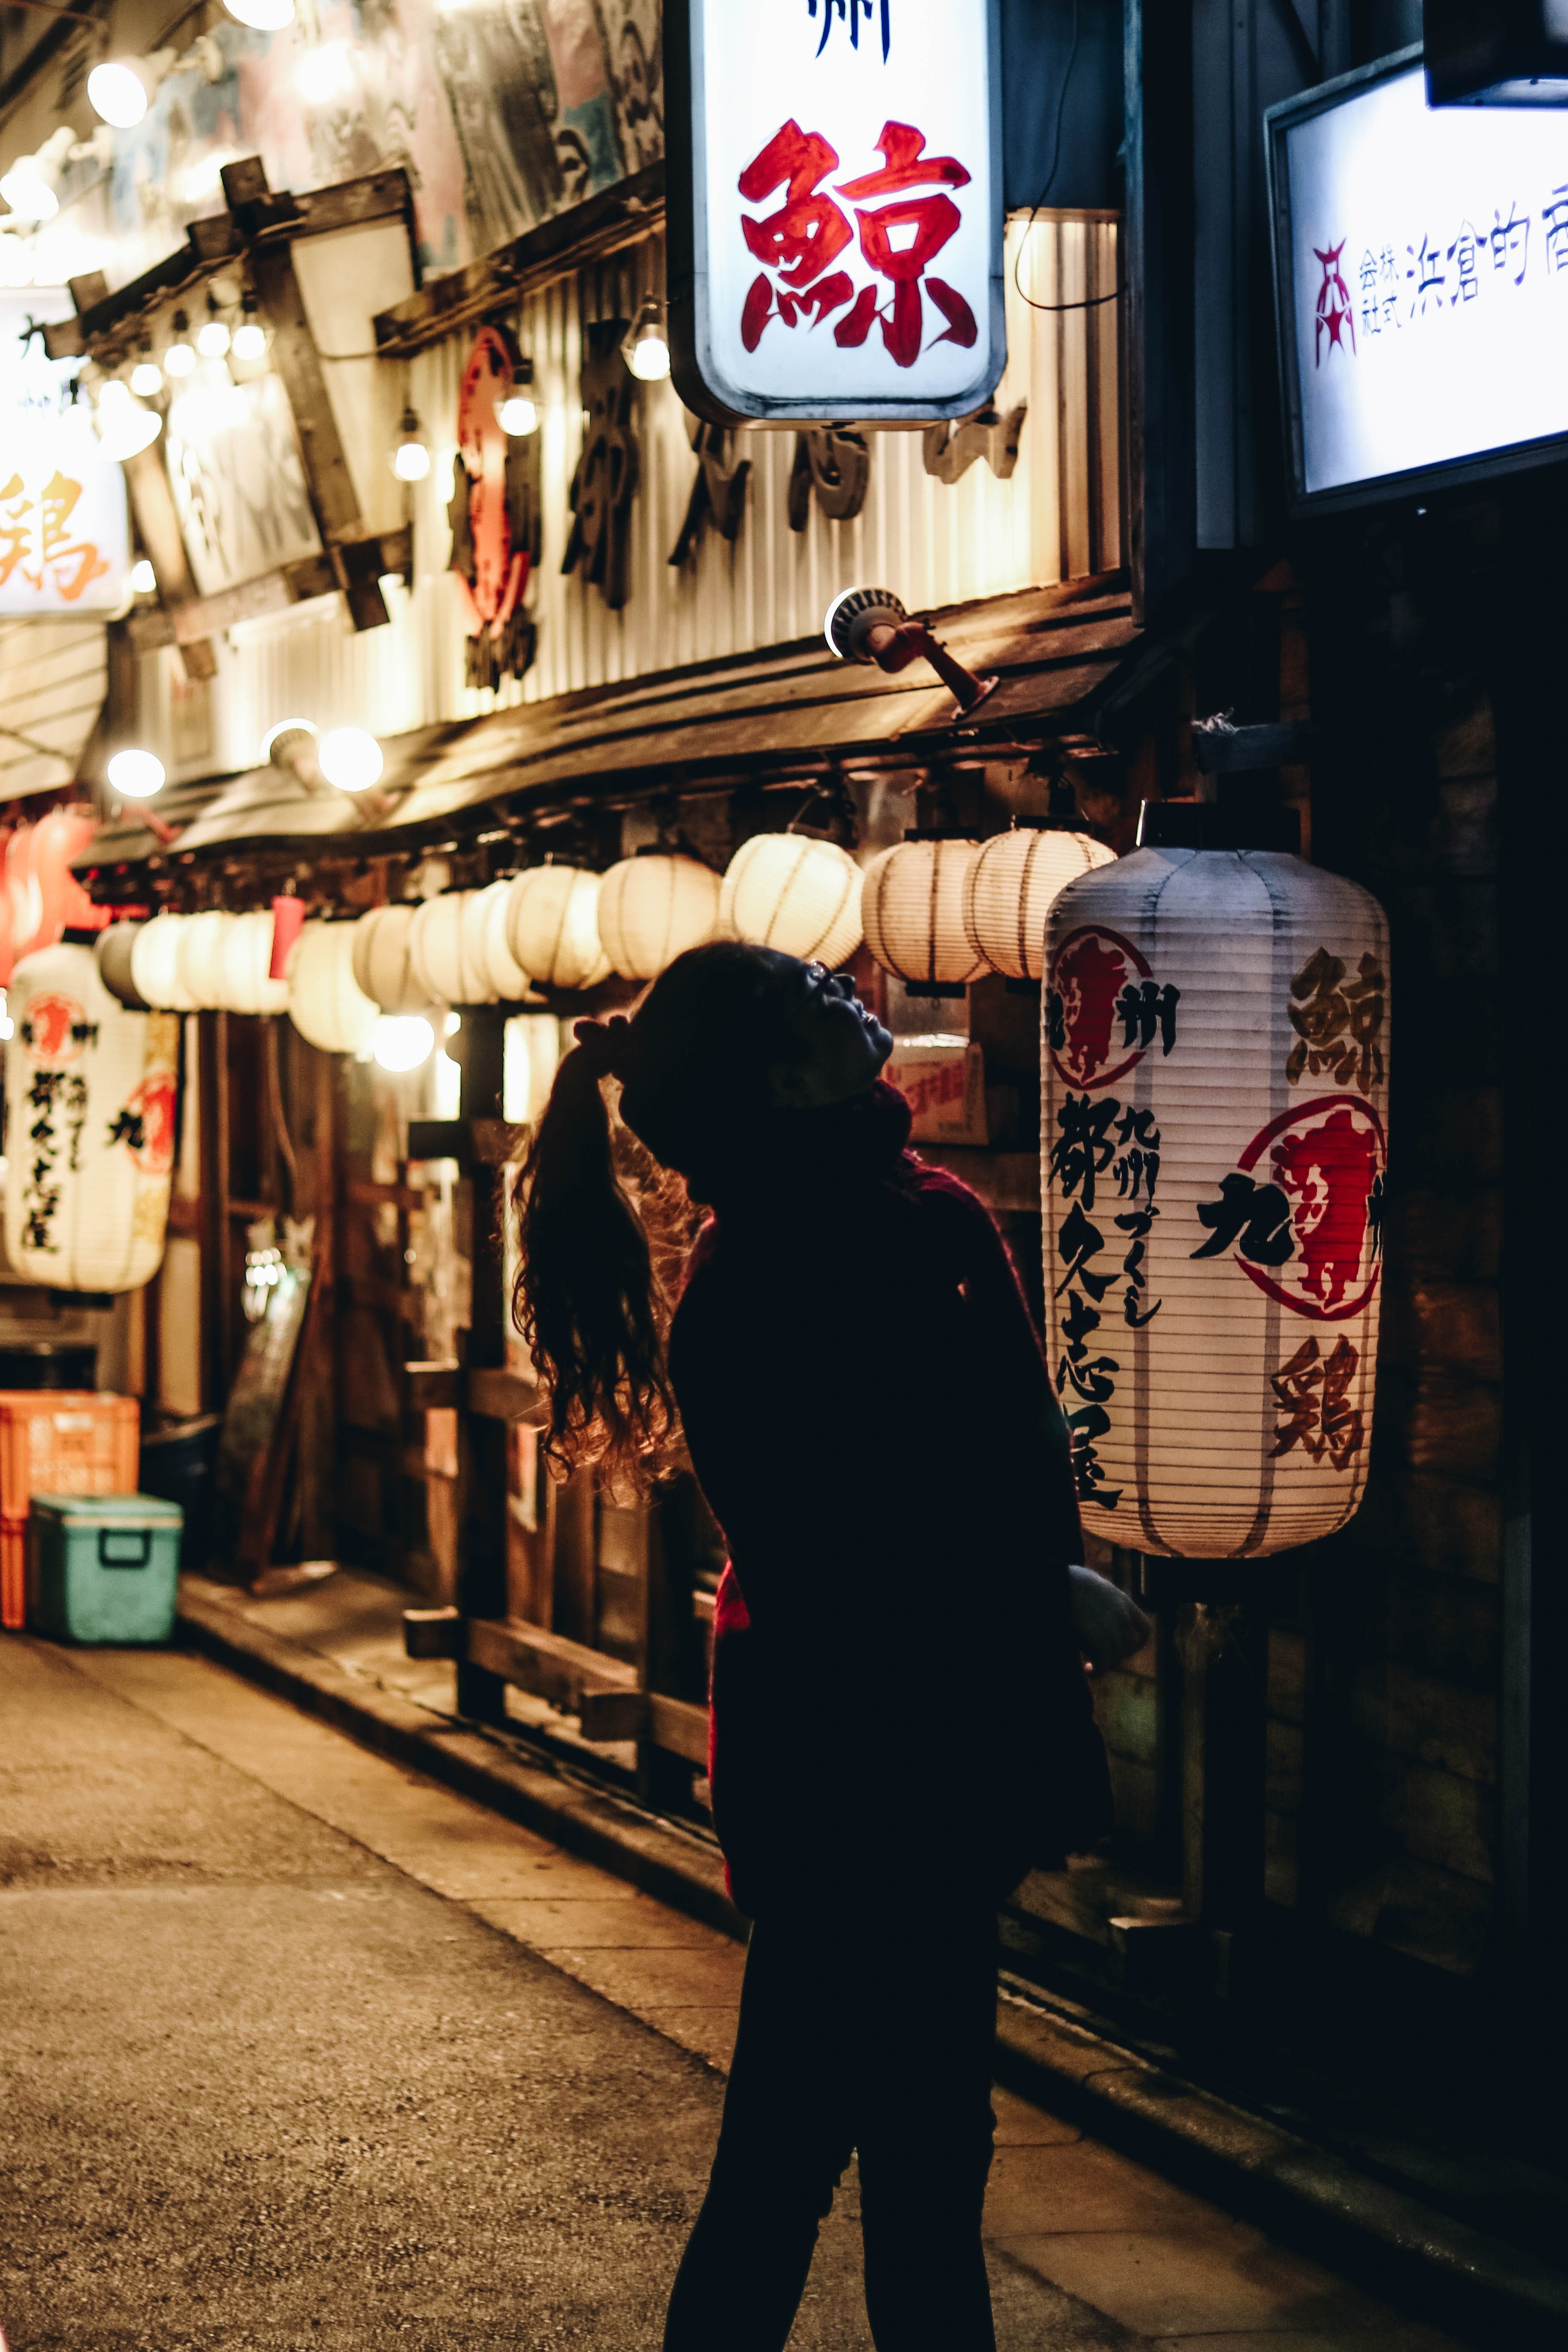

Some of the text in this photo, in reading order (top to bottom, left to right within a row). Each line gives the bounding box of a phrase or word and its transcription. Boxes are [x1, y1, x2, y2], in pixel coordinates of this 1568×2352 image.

[738, 118, 978, 368] 鯨
[1286, 947, 1385, 1095] 鯨
[1047, 1091, 1124, 1510] 都久志屋
[1112, 1105, 1162, 1328] 九州づくし
[1267, 1333, 1365, 1472] 鶏
